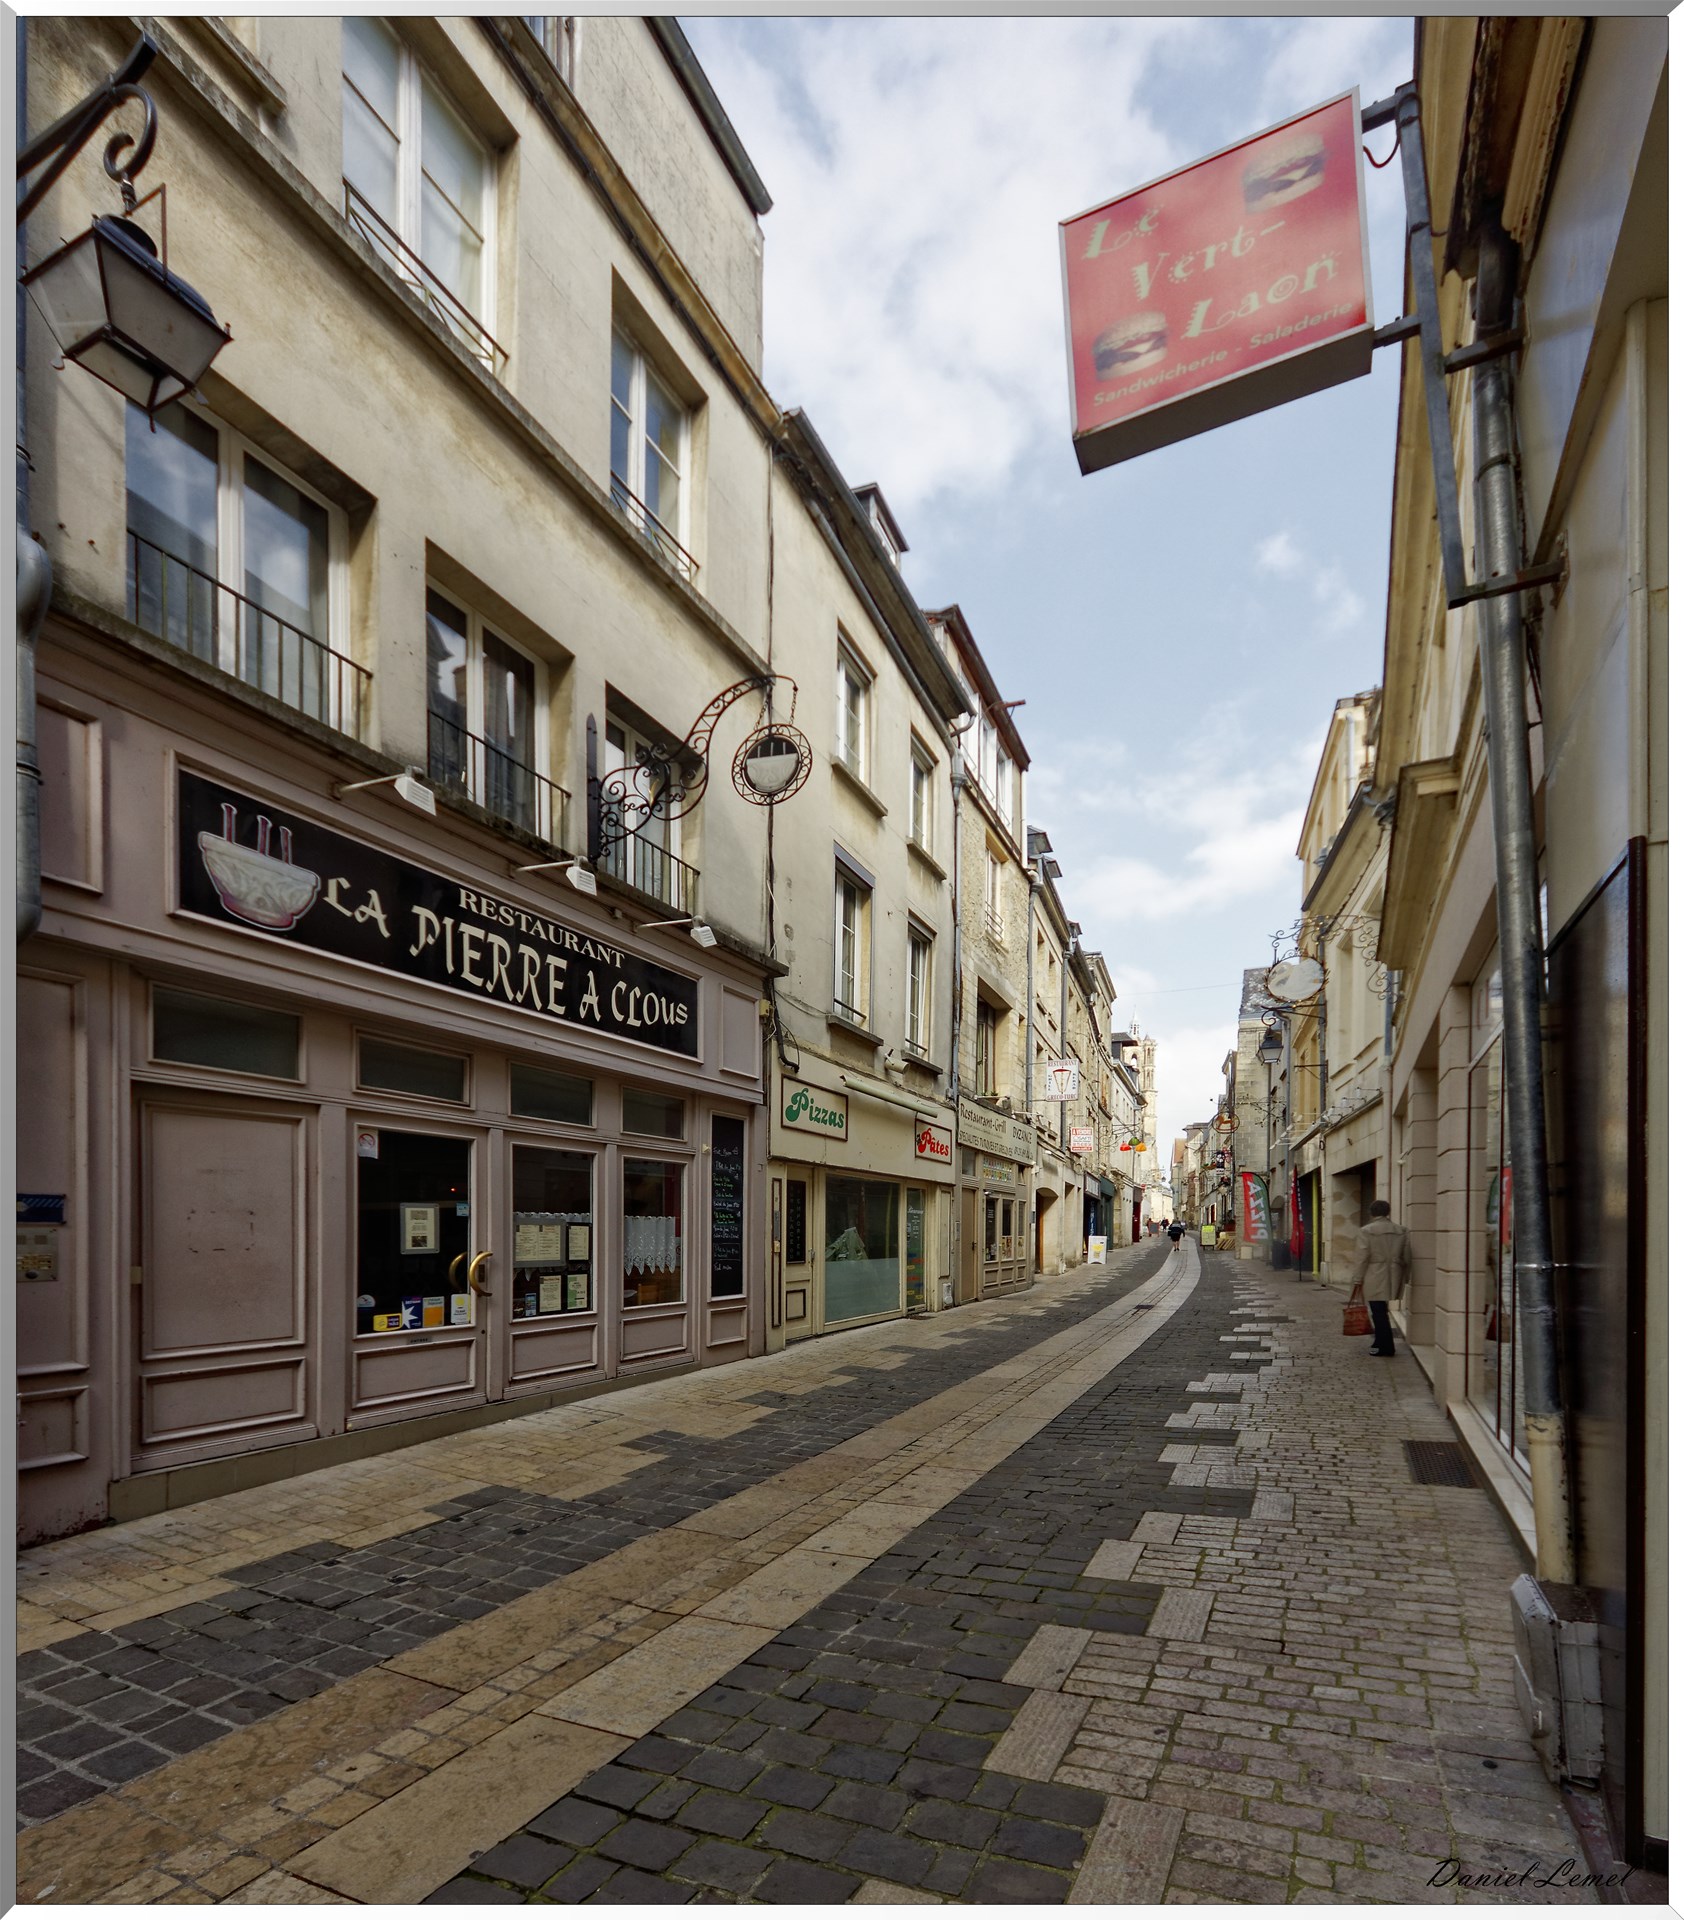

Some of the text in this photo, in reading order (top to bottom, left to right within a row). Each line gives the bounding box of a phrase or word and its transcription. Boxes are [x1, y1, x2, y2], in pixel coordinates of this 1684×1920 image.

[1081, 203, 1165, 260] Le
[1180, 249, 1343, 339] Laon
[1093, 348, 1229, 407] Sandwicherie
[1249, 301, 1354, 349] Saladerie
[323, 877, 391, 939] LA
[409, 904, 568, 1016] PIERRE
[579, 970, 601, 1022] A
[458, 887, 626, 969] RESTAURANT
[785, 1087, 844, 1128] Pizzas
[917, 1128, 949, 1156] Pâtes
